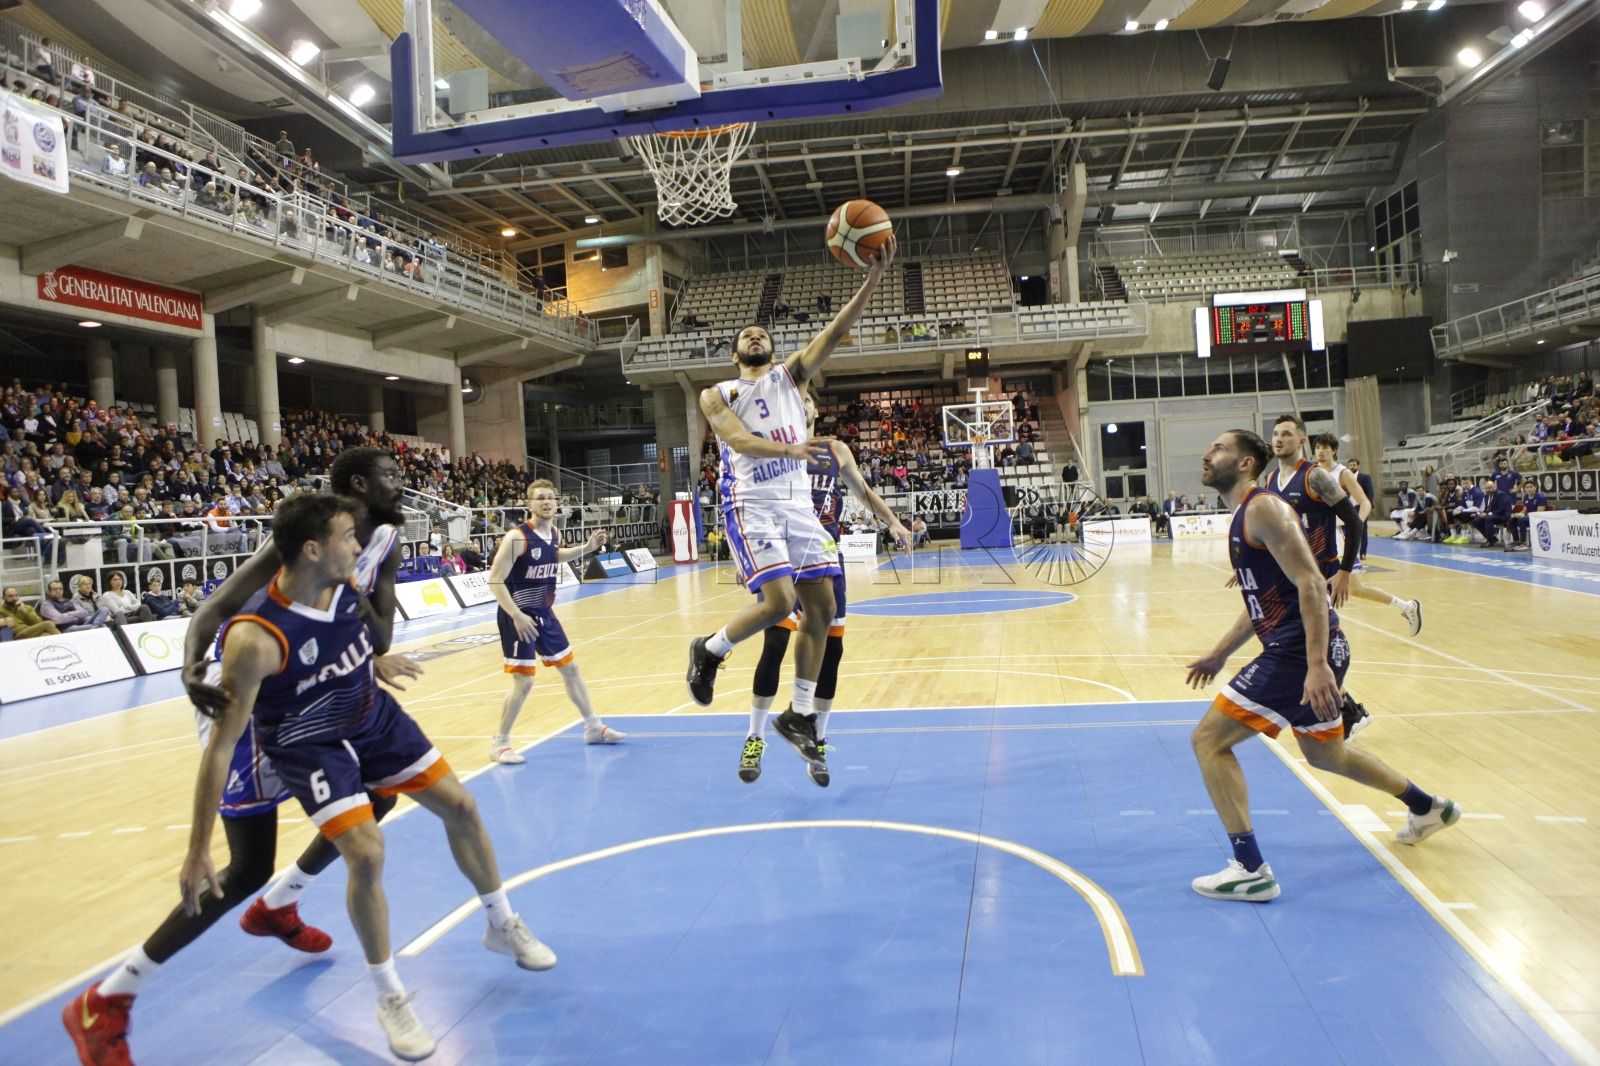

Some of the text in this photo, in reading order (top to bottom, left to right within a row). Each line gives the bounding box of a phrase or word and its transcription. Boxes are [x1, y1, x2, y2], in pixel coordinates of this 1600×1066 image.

[58, 275, 199, 321] GENERALITAT VALENCIANA
[755, 398, 770, 419] 3
[770, 425, 798, 445] HLA
[753, 457, 802, 484] ALICANT
[513, 640, 519, 657] 1
[45, 671, 91, 687] EL SORELL
[310, 768, 332, 804] 6
